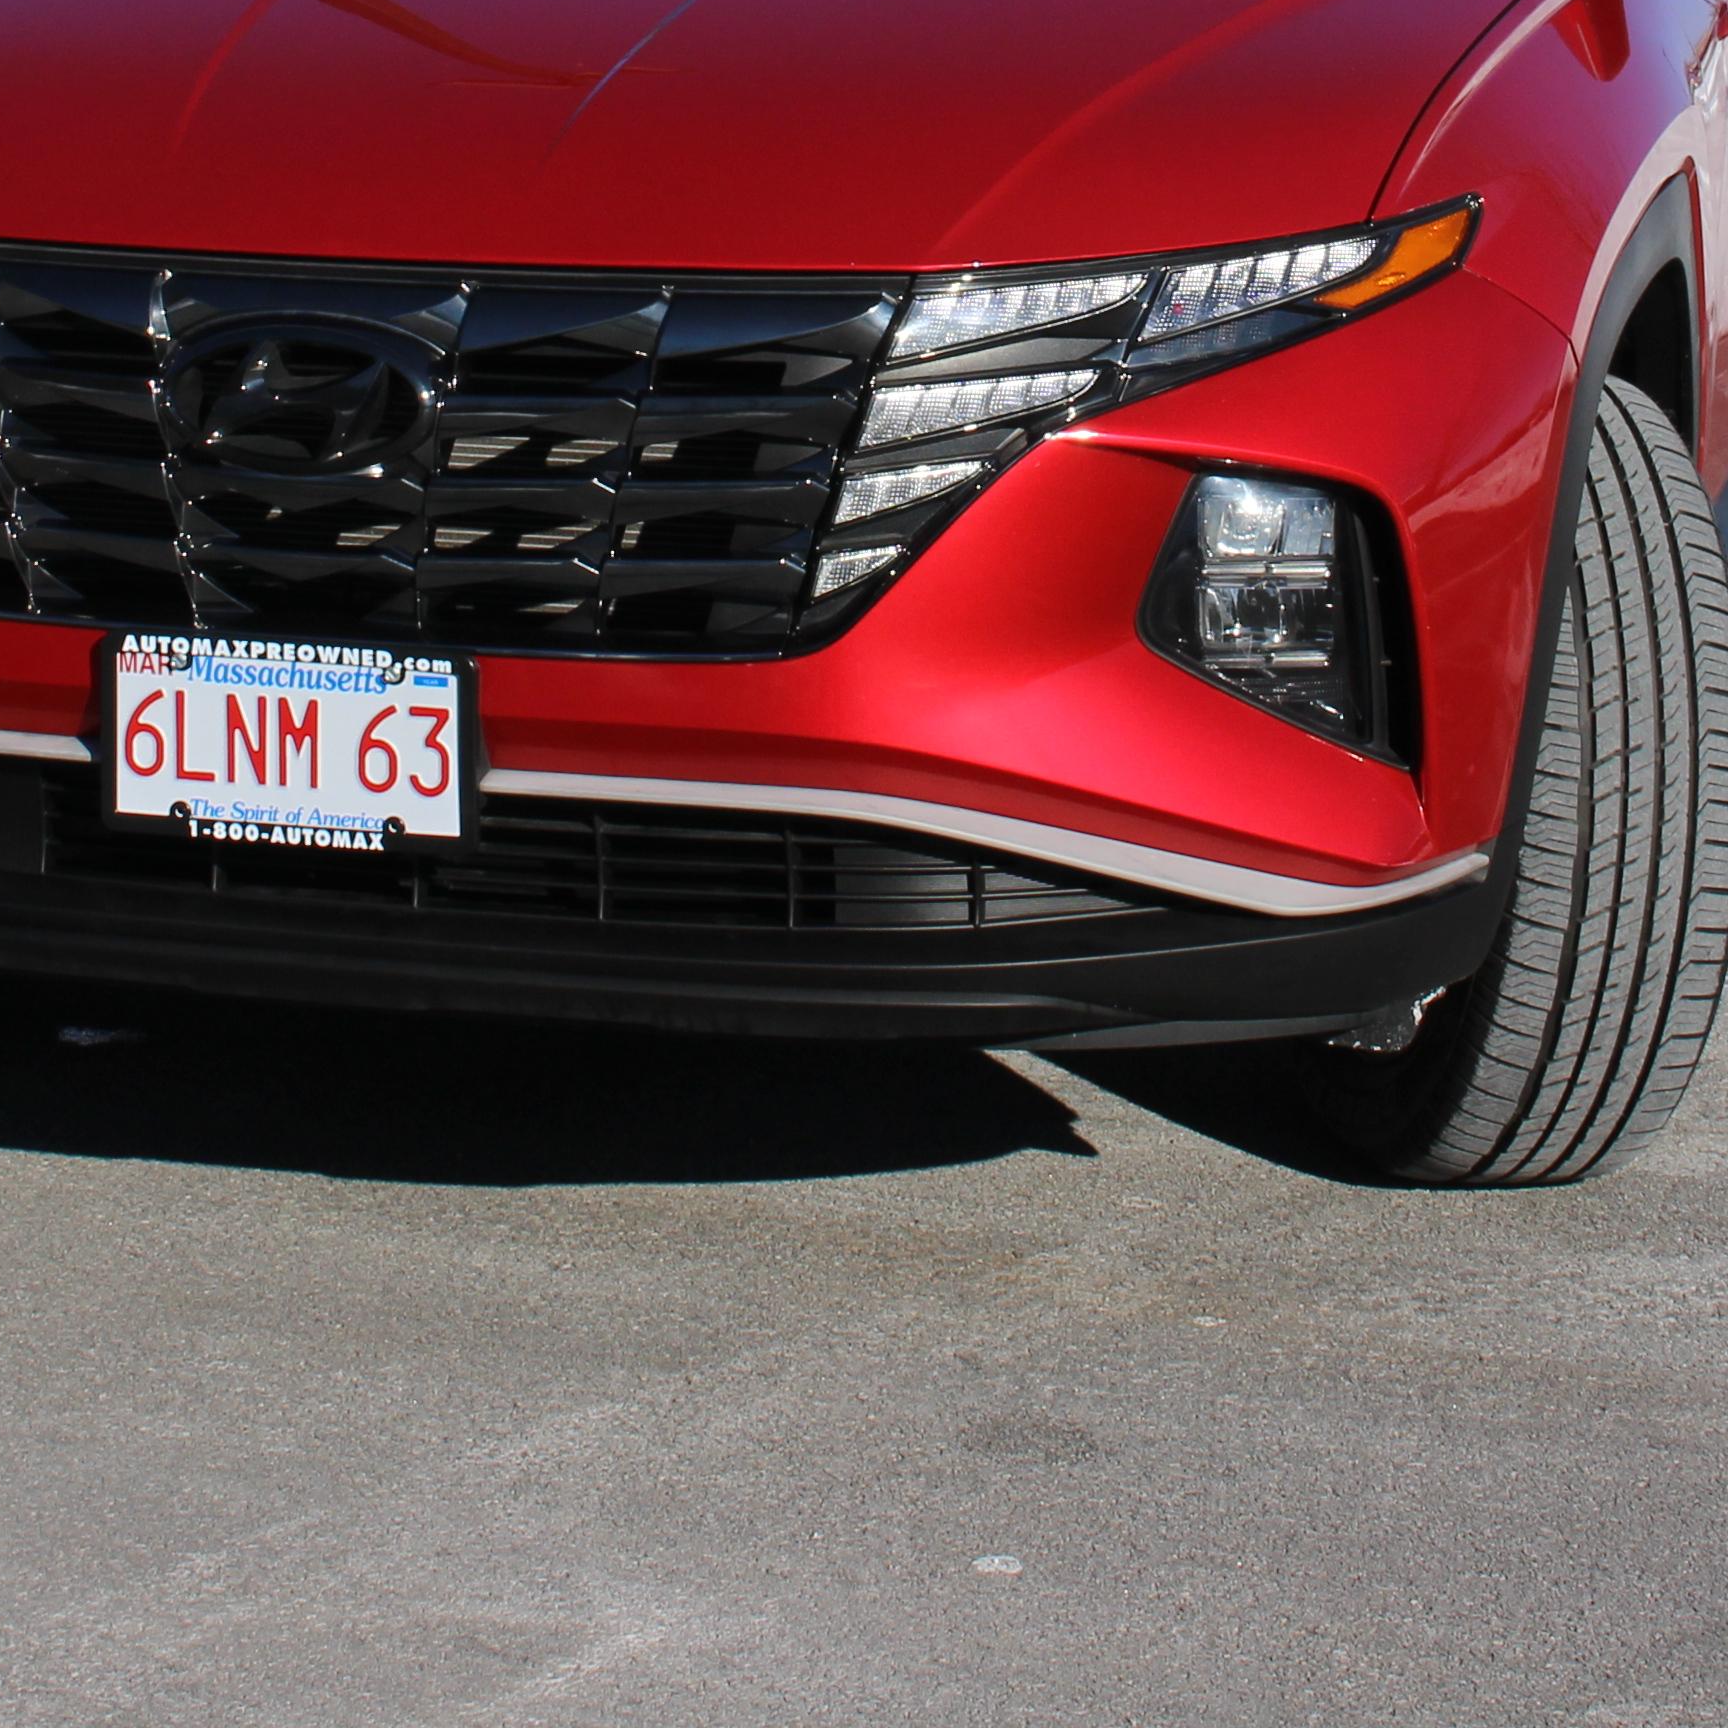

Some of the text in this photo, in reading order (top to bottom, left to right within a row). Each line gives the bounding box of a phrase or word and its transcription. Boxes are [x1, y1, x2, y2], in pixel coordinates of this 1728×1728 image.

[121, 634, 452, 674] AUTOMAXPREOWNED.com
[186, 655, 387, 695] Massachusetts
[124, 689, 450, 798] 6LNM 63
[190, 798, 385, 830] The Spirit of America
[189, 819, 385, 851] 1-800-AUTOMAX
